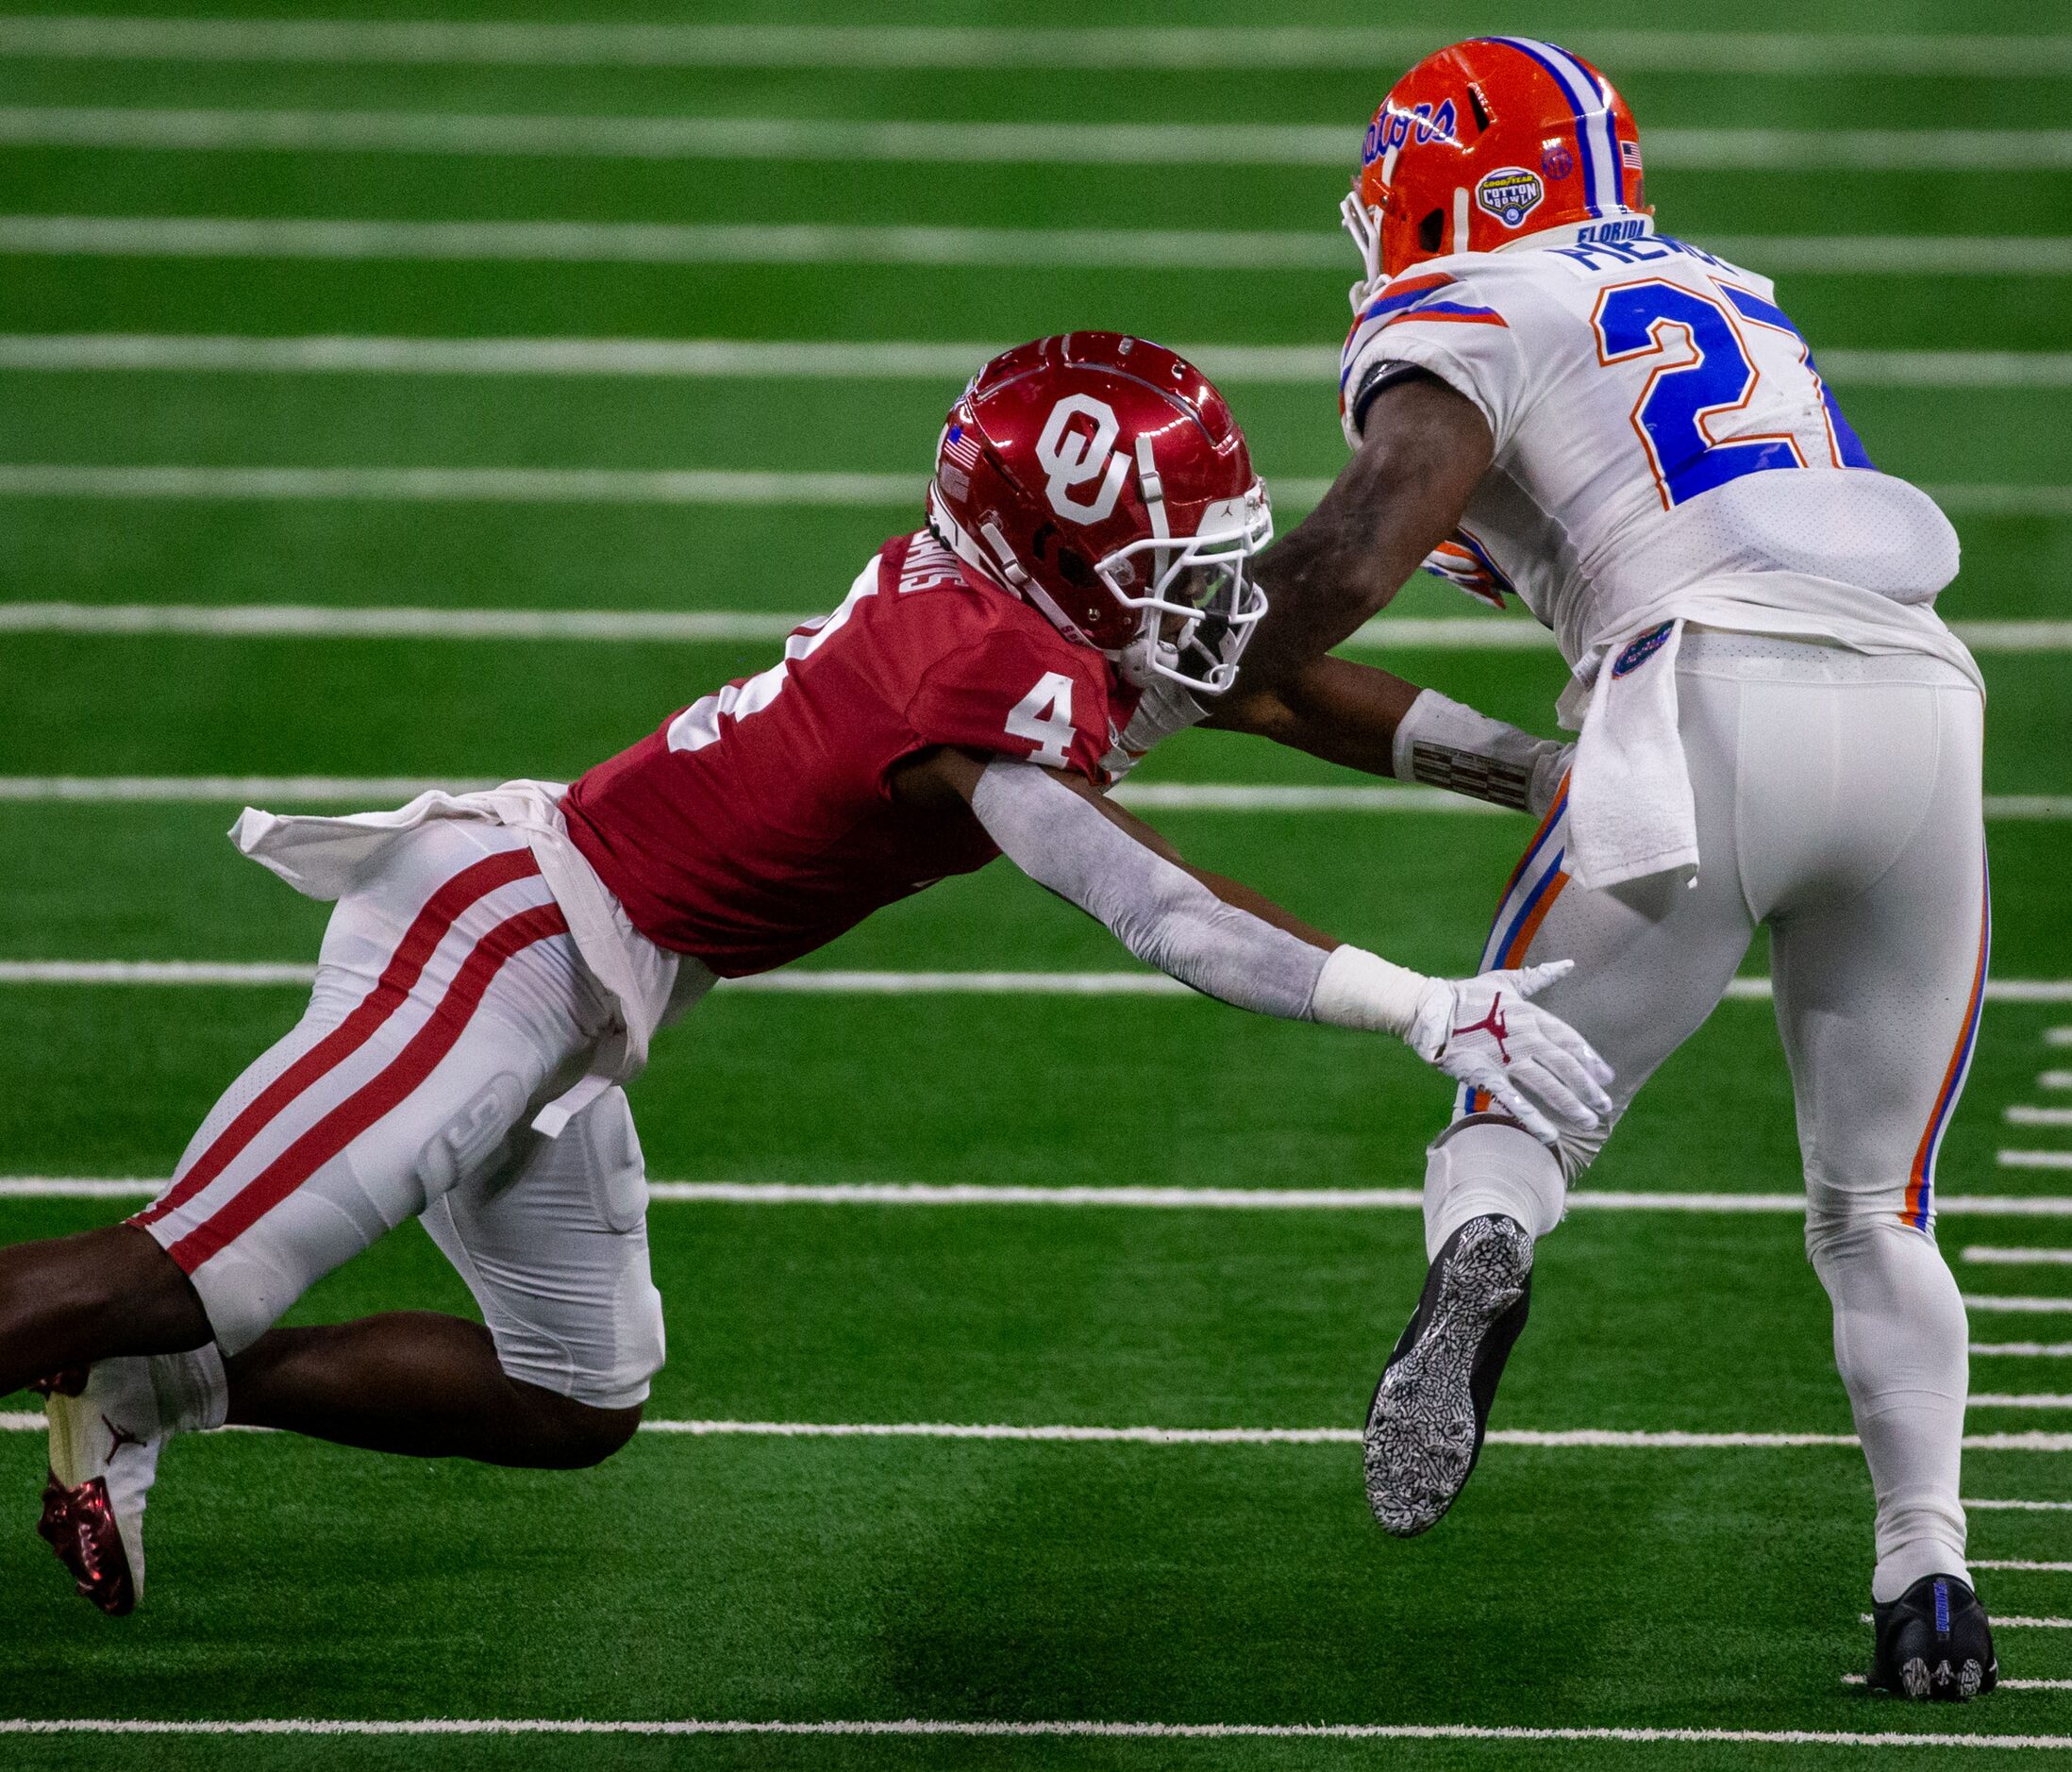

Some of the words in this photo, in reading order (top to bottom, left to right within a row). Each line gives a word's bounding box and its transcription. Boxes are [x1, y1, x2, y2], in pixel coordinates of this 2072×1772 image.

[1363, 99, 1457, 165] ators
[1483, 176, 1532, 188] GOODYEAR
[1483, 183, 1536, 206] COTTON
[1495, 195, 1529, 209] BOWL
[1578, 220, 1645, 242] FLORIDA
[1035, 393, 1131, 525] OU
[1004, 671, 1076, 769] 4
